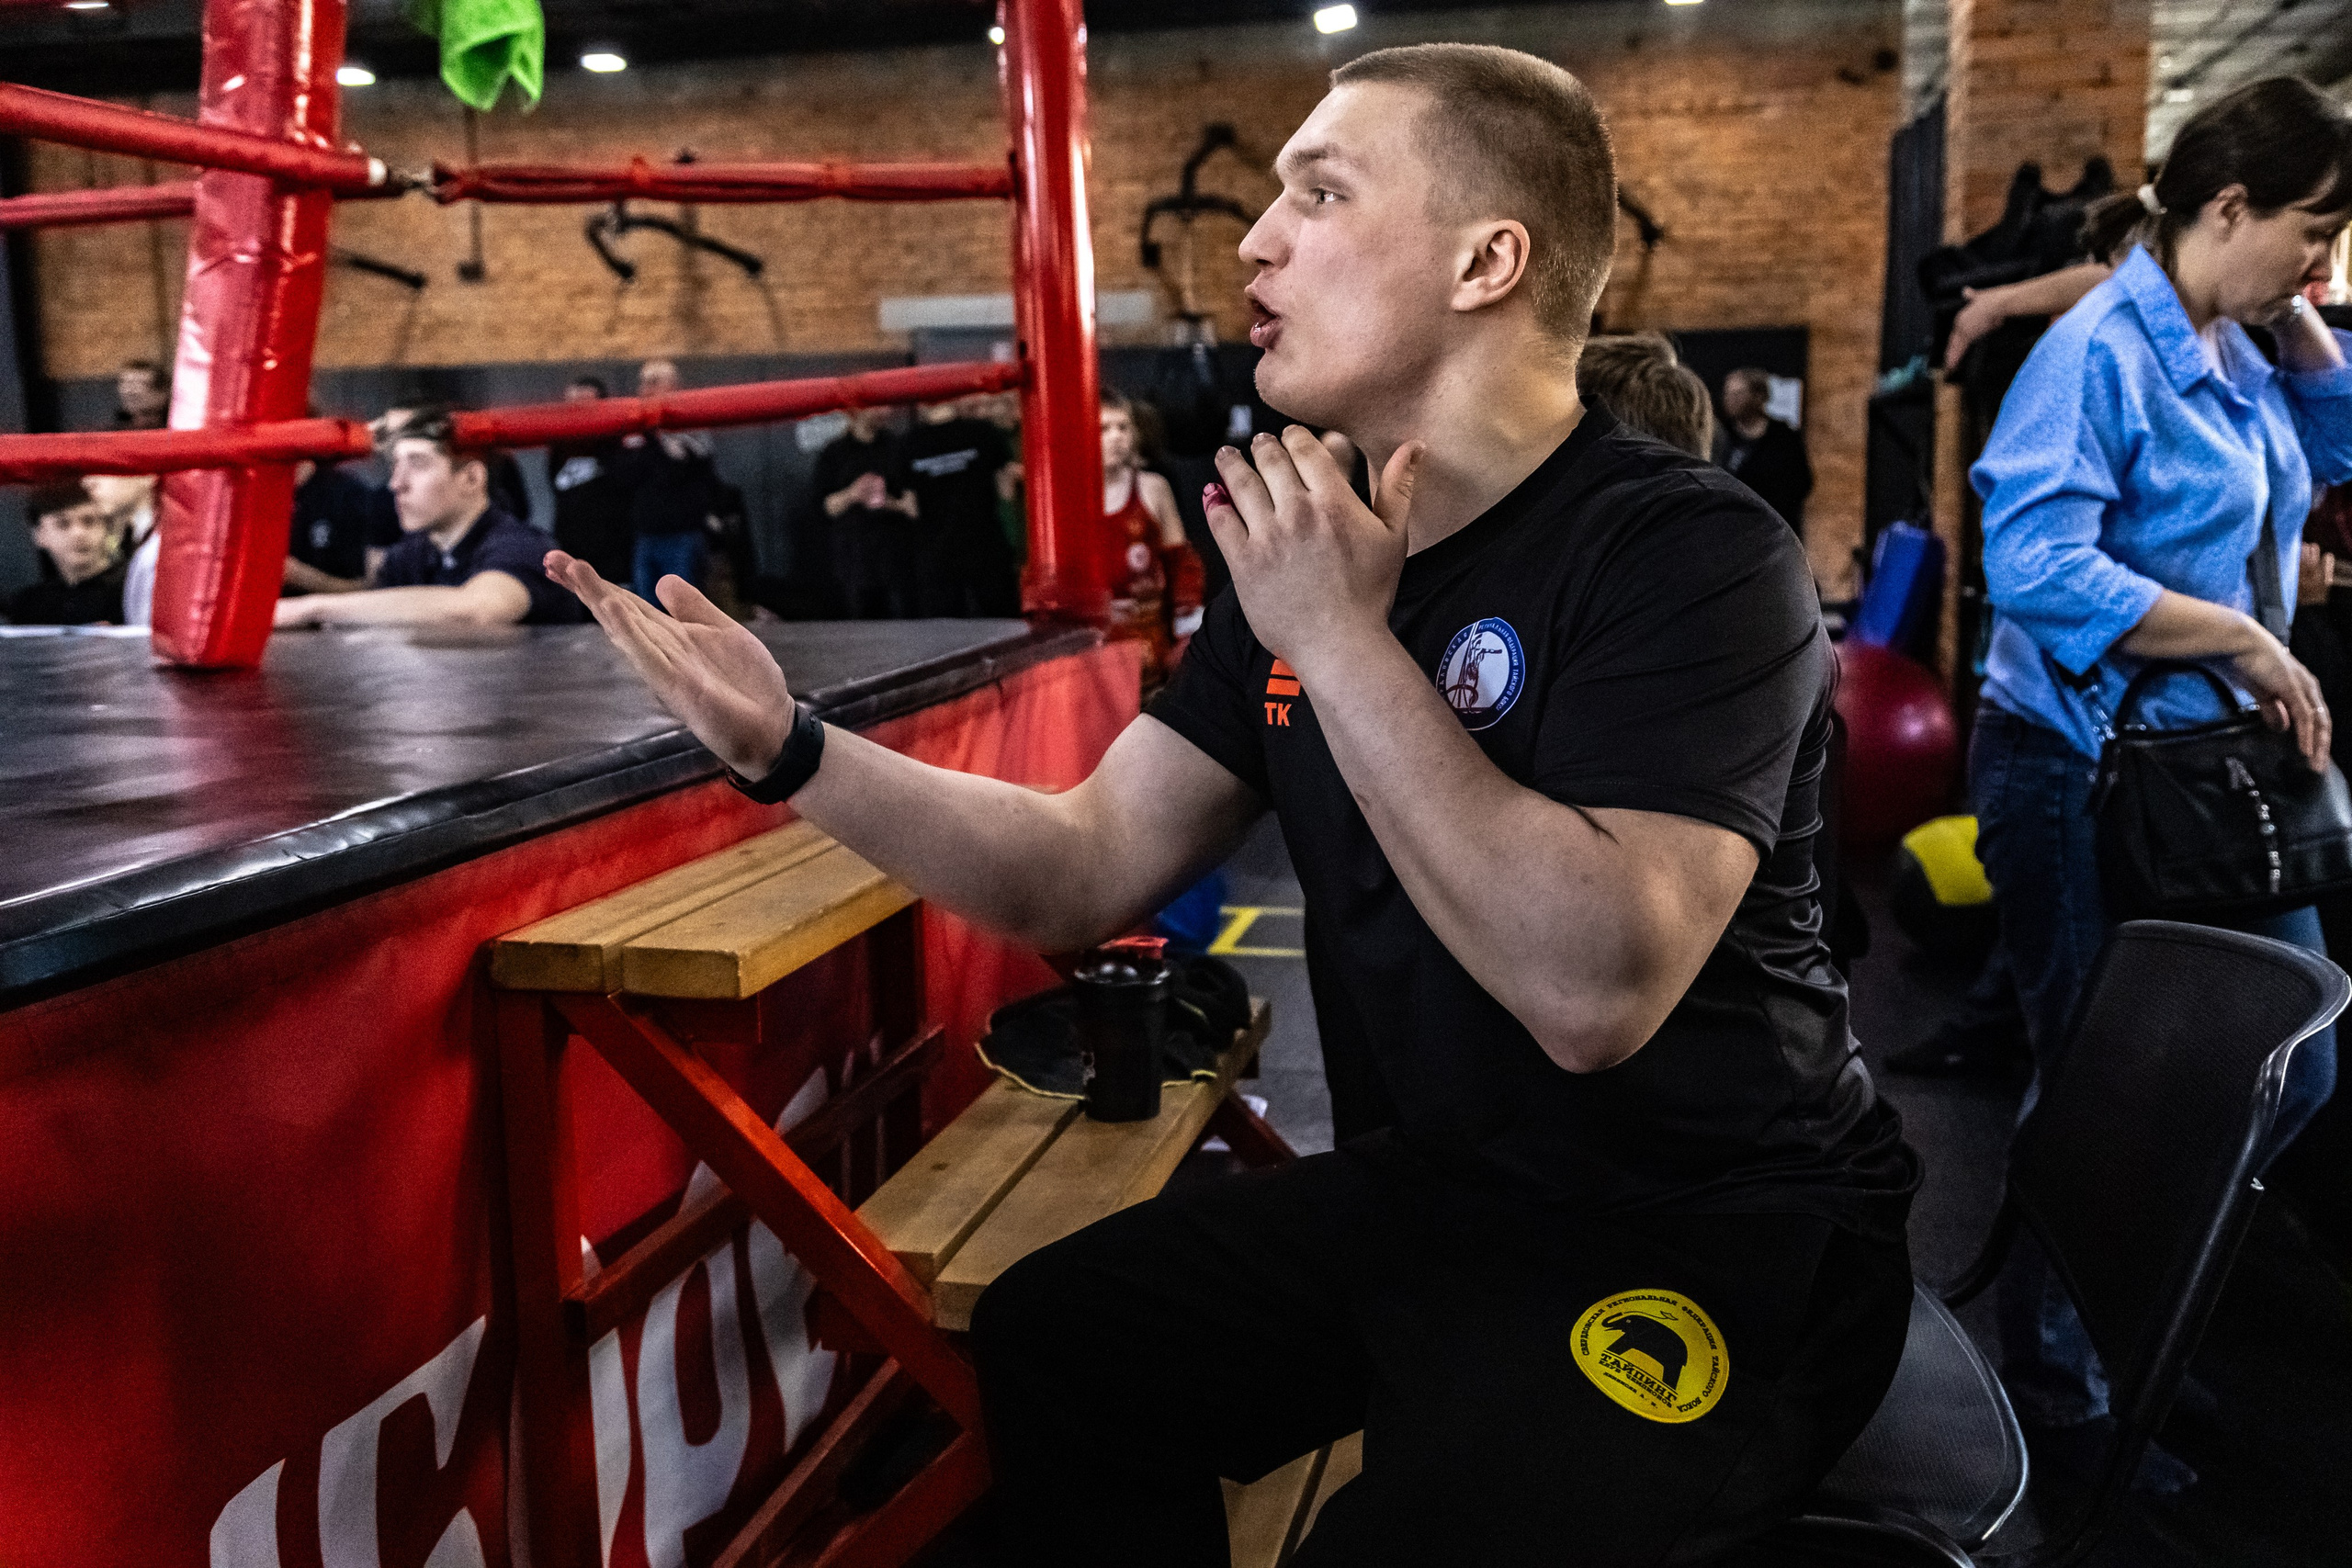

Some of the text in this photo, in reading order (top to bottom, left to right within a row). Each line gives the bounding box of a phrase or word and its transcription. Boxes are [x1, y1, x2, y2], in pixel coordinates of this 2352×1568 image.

[1506, 669, 1521, 697] ТАЙСКОГО
[1579, 1294, 1721, 1413] СВЕРДЛОВСКАЯ РЕГИОНАЛЬНАЯ ФЕДЕРАЦИЯ ТАЙСКОГО БОКСА
[1600, 1352, 1679, 1402] ТАЙПИНГ
[1599, 1360, 1621, 1373] КЛУБ
[1625, 1373, 1673, 1408] ЧЕМПИОНОВ
